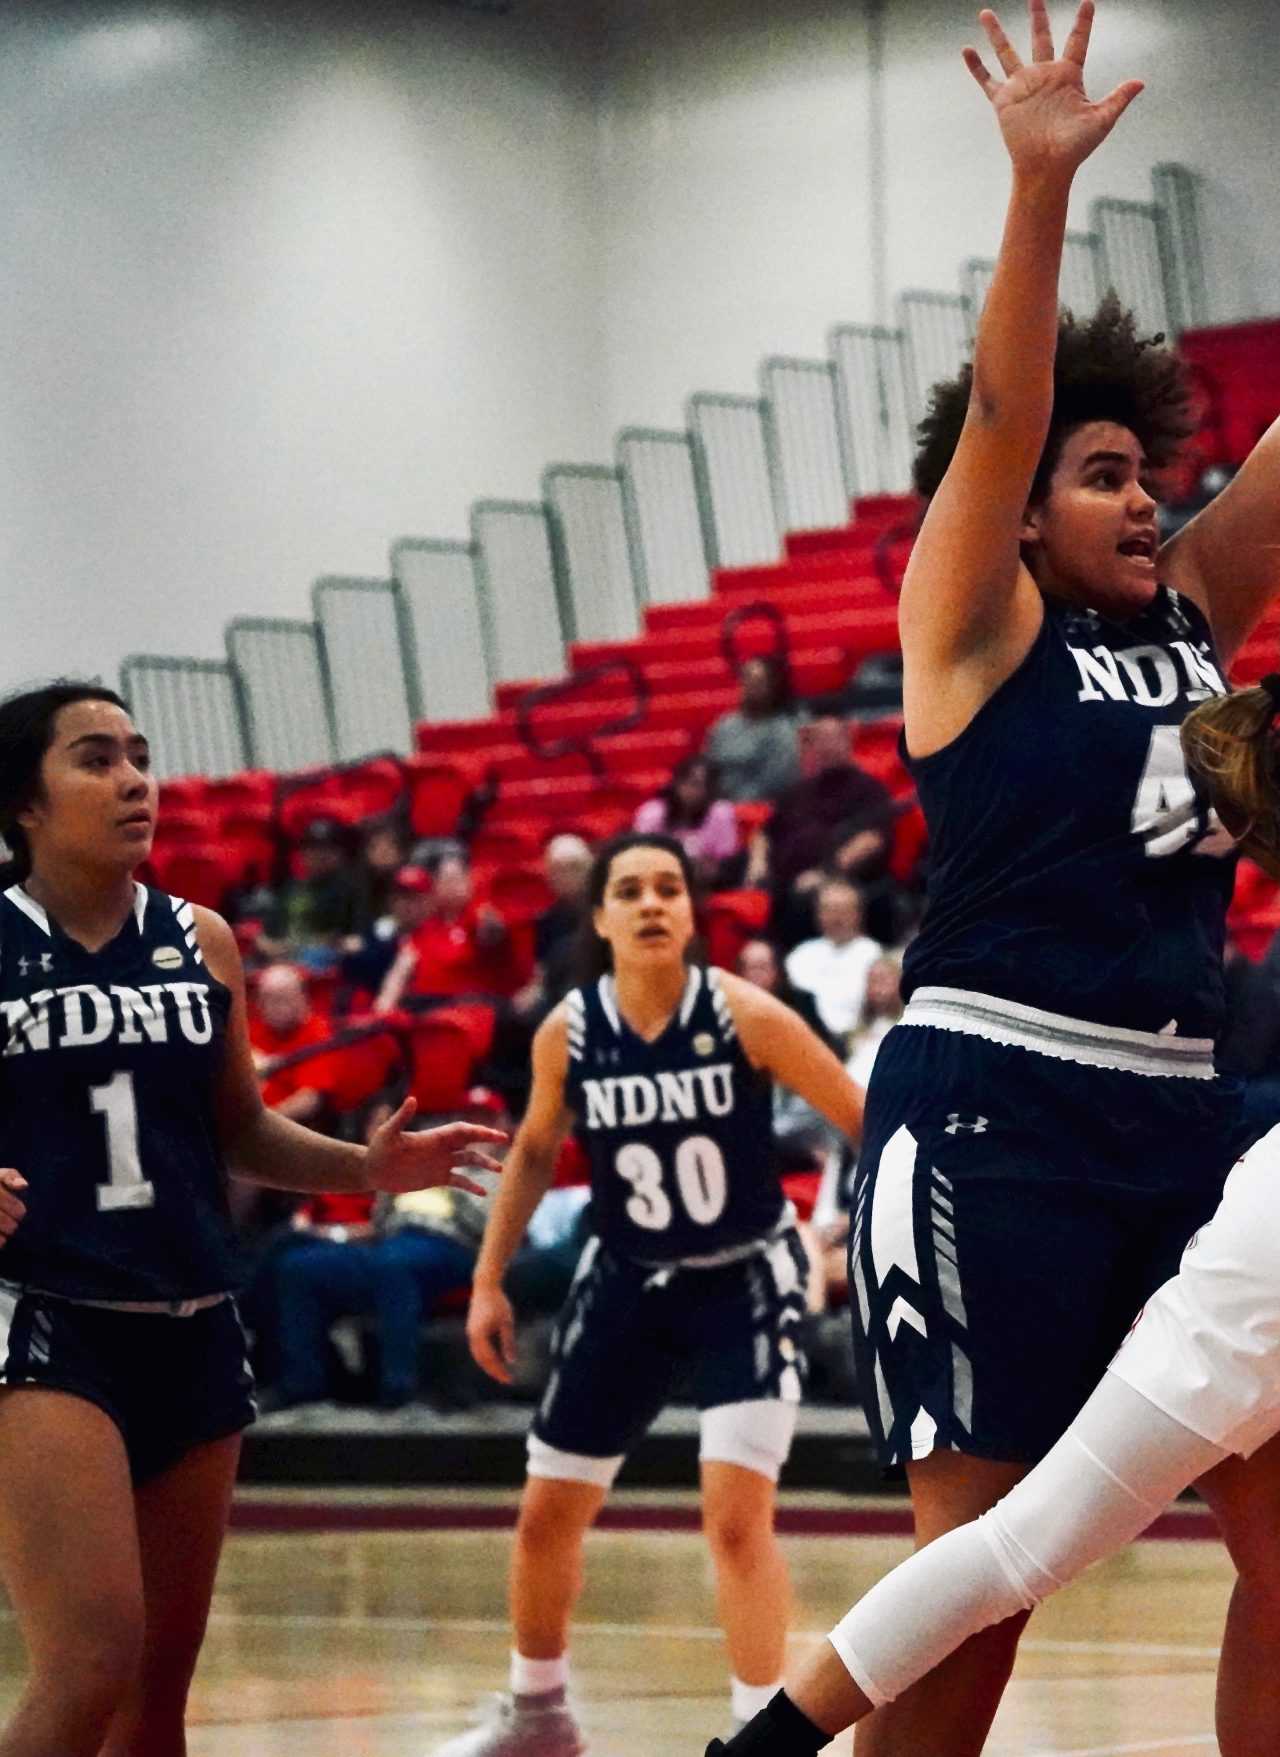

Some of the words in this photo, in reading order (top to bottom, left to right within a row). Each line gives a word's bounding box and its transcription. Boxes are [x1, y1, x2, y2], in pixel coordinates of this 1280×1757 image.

[1065, 641, 1228, 707] NDN
[0, 982, 213, 1056] NDNU
[582, 1064, 733, 1129] NDNU
[90, 1071, 154, 1211] 1
[616, 1136, 727, 1231] 30
